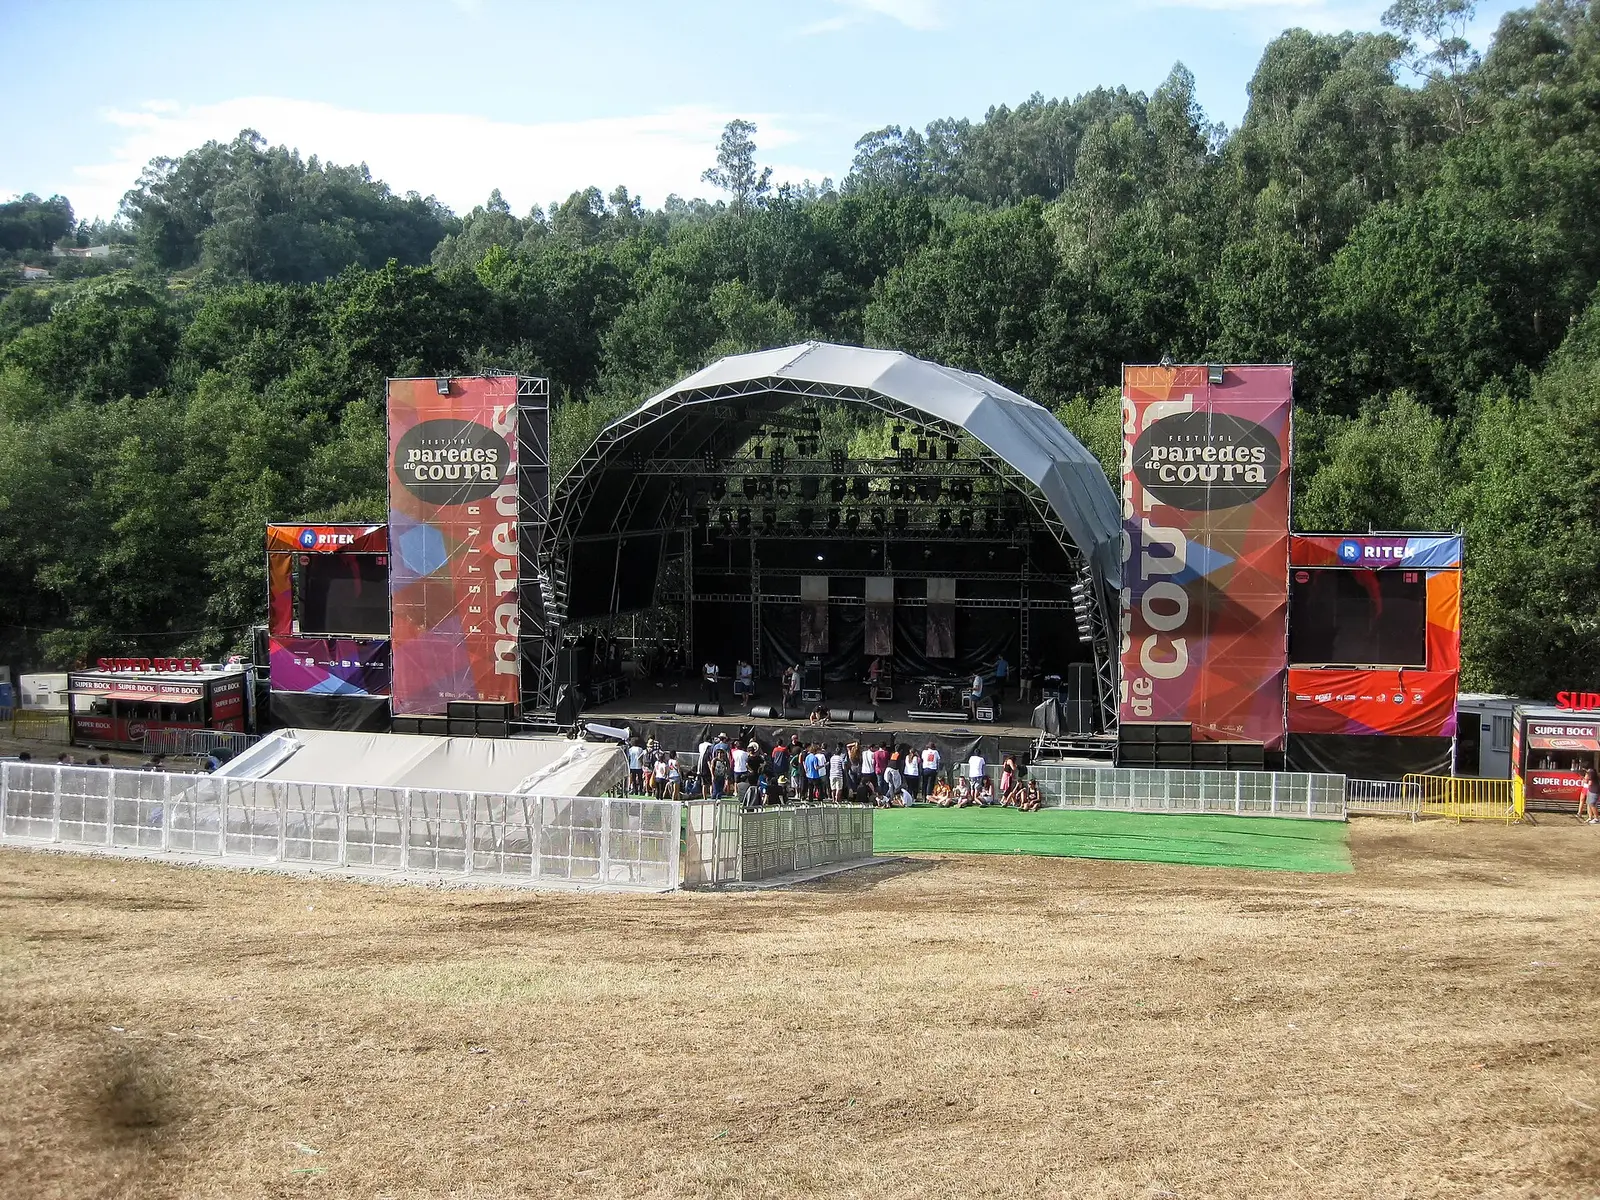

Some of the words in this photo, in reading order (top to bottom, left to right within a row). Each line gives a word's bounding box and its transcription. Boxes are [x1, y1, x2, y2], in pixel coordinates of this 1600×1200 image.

[408, 447, 498, 463] paredes
[1150, 445, 1266, 463] paredes
[403, 462, 416, 470] de
[414, 462, 499, 480] coura
[1144, 460, 1161, 470] de
[1158, 464, 1267, 483] coura
[304, 534, 313, 544] R
[318, 534, 355, 544] RITEK
[490, 404, 519, 676] pareds
[1344, 546, 1355, 557] R
[1364, 546, 1415, 558] RITEK
[467, 505, 482, 634] FESTIVA
[97, 657, 152, 673] SUPER
[154, 658, 204, 672] BOCK
[75, 681, 93, 689] SUPER
[93, 682, 111, 690] BOCK
[117, 683, 137, 691] SUPER
[137, 684, 155, 692] BOCK
[161, 686, 180, 694] SUPER
[181, 687, 199, 695] BOCK
[213, 685, 227, 694] SUPER
[227, 682, 240, 690] BOCK
[1131, 677, 1153, 717] de
[215, 699, 228, 708] SUPER
[1534, 726, 1564, 735] SUPER
[1566, 727, 1594, 736] BOCK
[1532, 777, 1561, 786] SUPER
